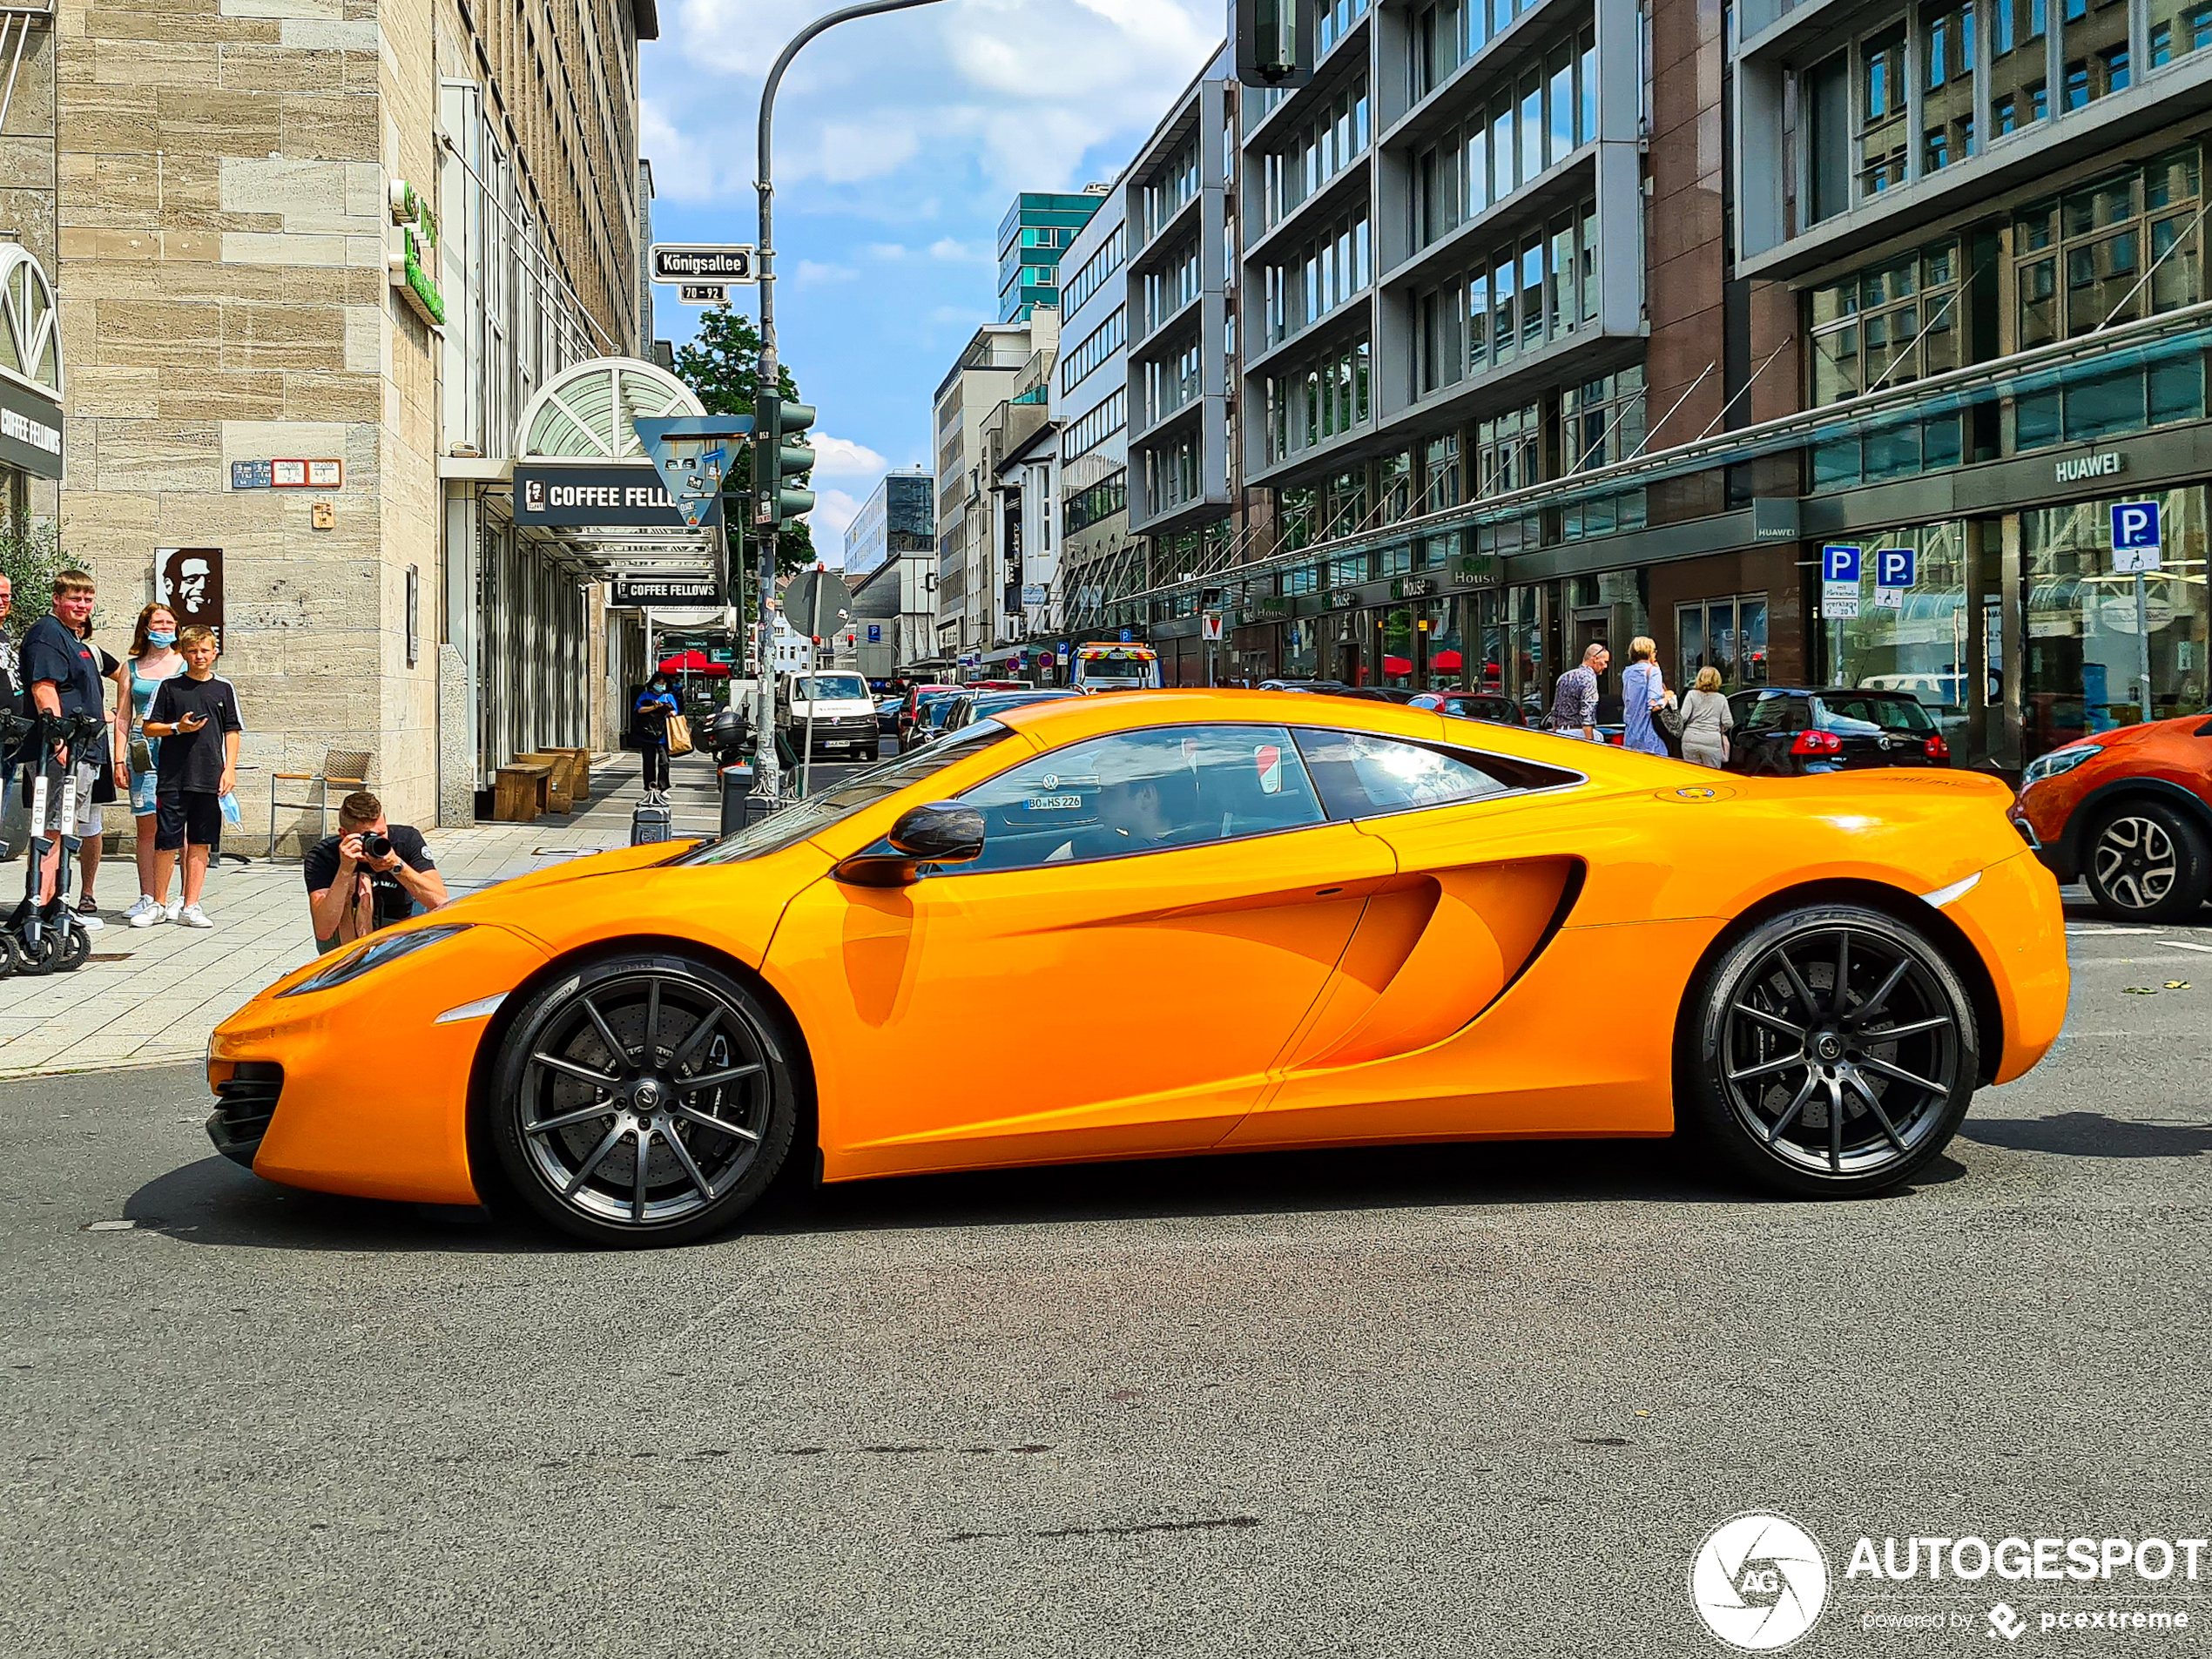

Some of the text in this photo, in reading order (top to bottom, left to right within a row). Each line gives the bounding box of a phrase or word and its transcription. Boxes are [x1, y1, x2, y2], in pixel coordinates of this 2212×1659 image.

[664, 254, 742, 275] Königsallee
[685, 287, 698, 299] 70
[706, 287, 719, 299] 92
[2055, 452, 2121, 483] HUAWEI
[550, 486, 620, 507] COFFEE
[2122, 509, 2148, 544] P
[1831, 551, 1851, 579] P
[1885, 554, 1906, 582] P
[1403, 577, 1426, 597] House
[1454, 571, 1499, 583] House
[631, 584, 715, 597] COFFEE FELLOWS
[1257, 609, 1289, 617] House
[34, 788, 45, 825] BIRD
[63, 787, 74, 823] BIRD
[1028, 796, 1081, 808] BO HS 226
